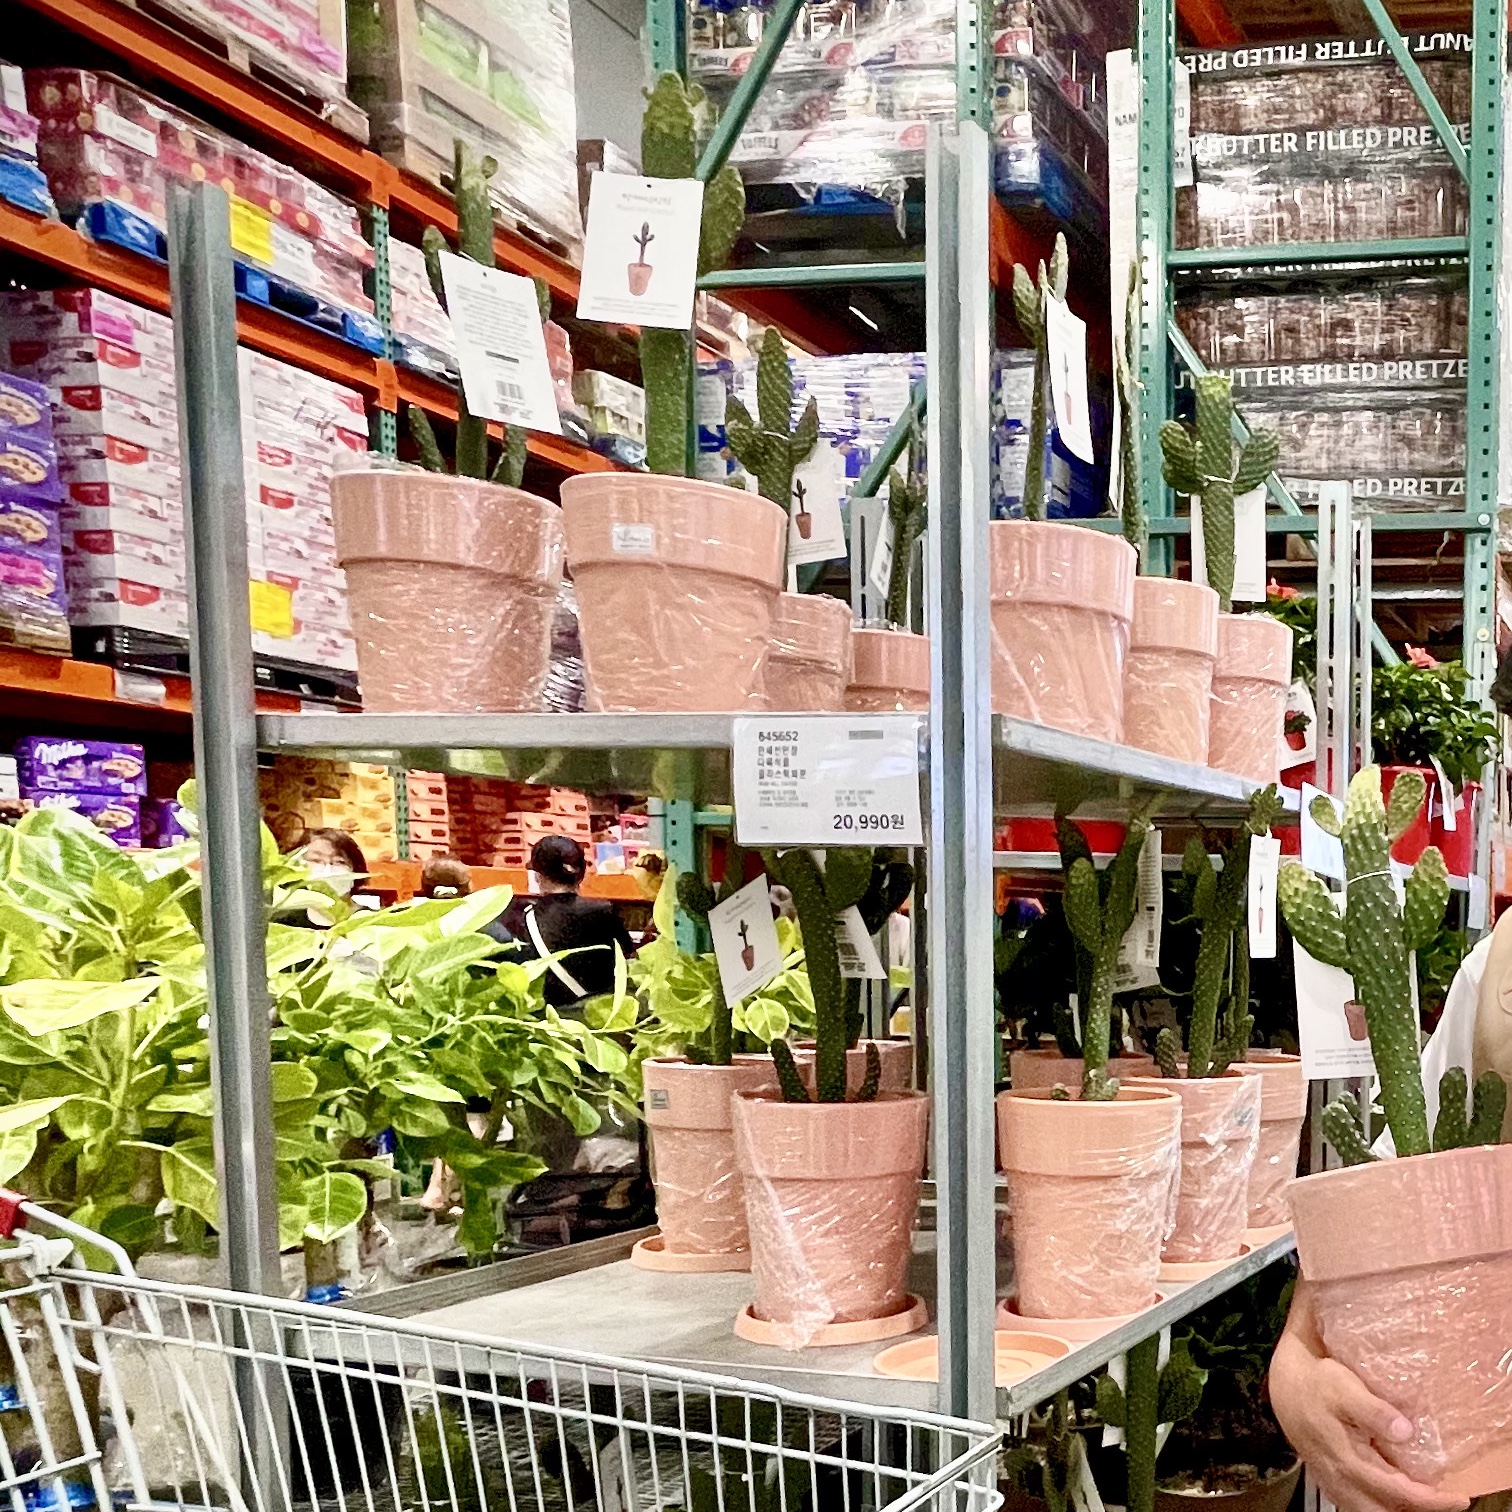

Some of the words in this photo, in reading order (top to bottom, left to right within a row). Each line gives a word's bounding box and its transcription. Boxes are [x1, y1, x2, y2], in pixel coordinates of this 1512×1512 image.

[1233, 43, 1307, 68] FILLED
[1306, 127, 1382, 152] FILLED
[1299, 362, 1379, 385] FILLED
[35, 741, 88, 765] Milka
[833, 814, 905, 832] 20,990원
